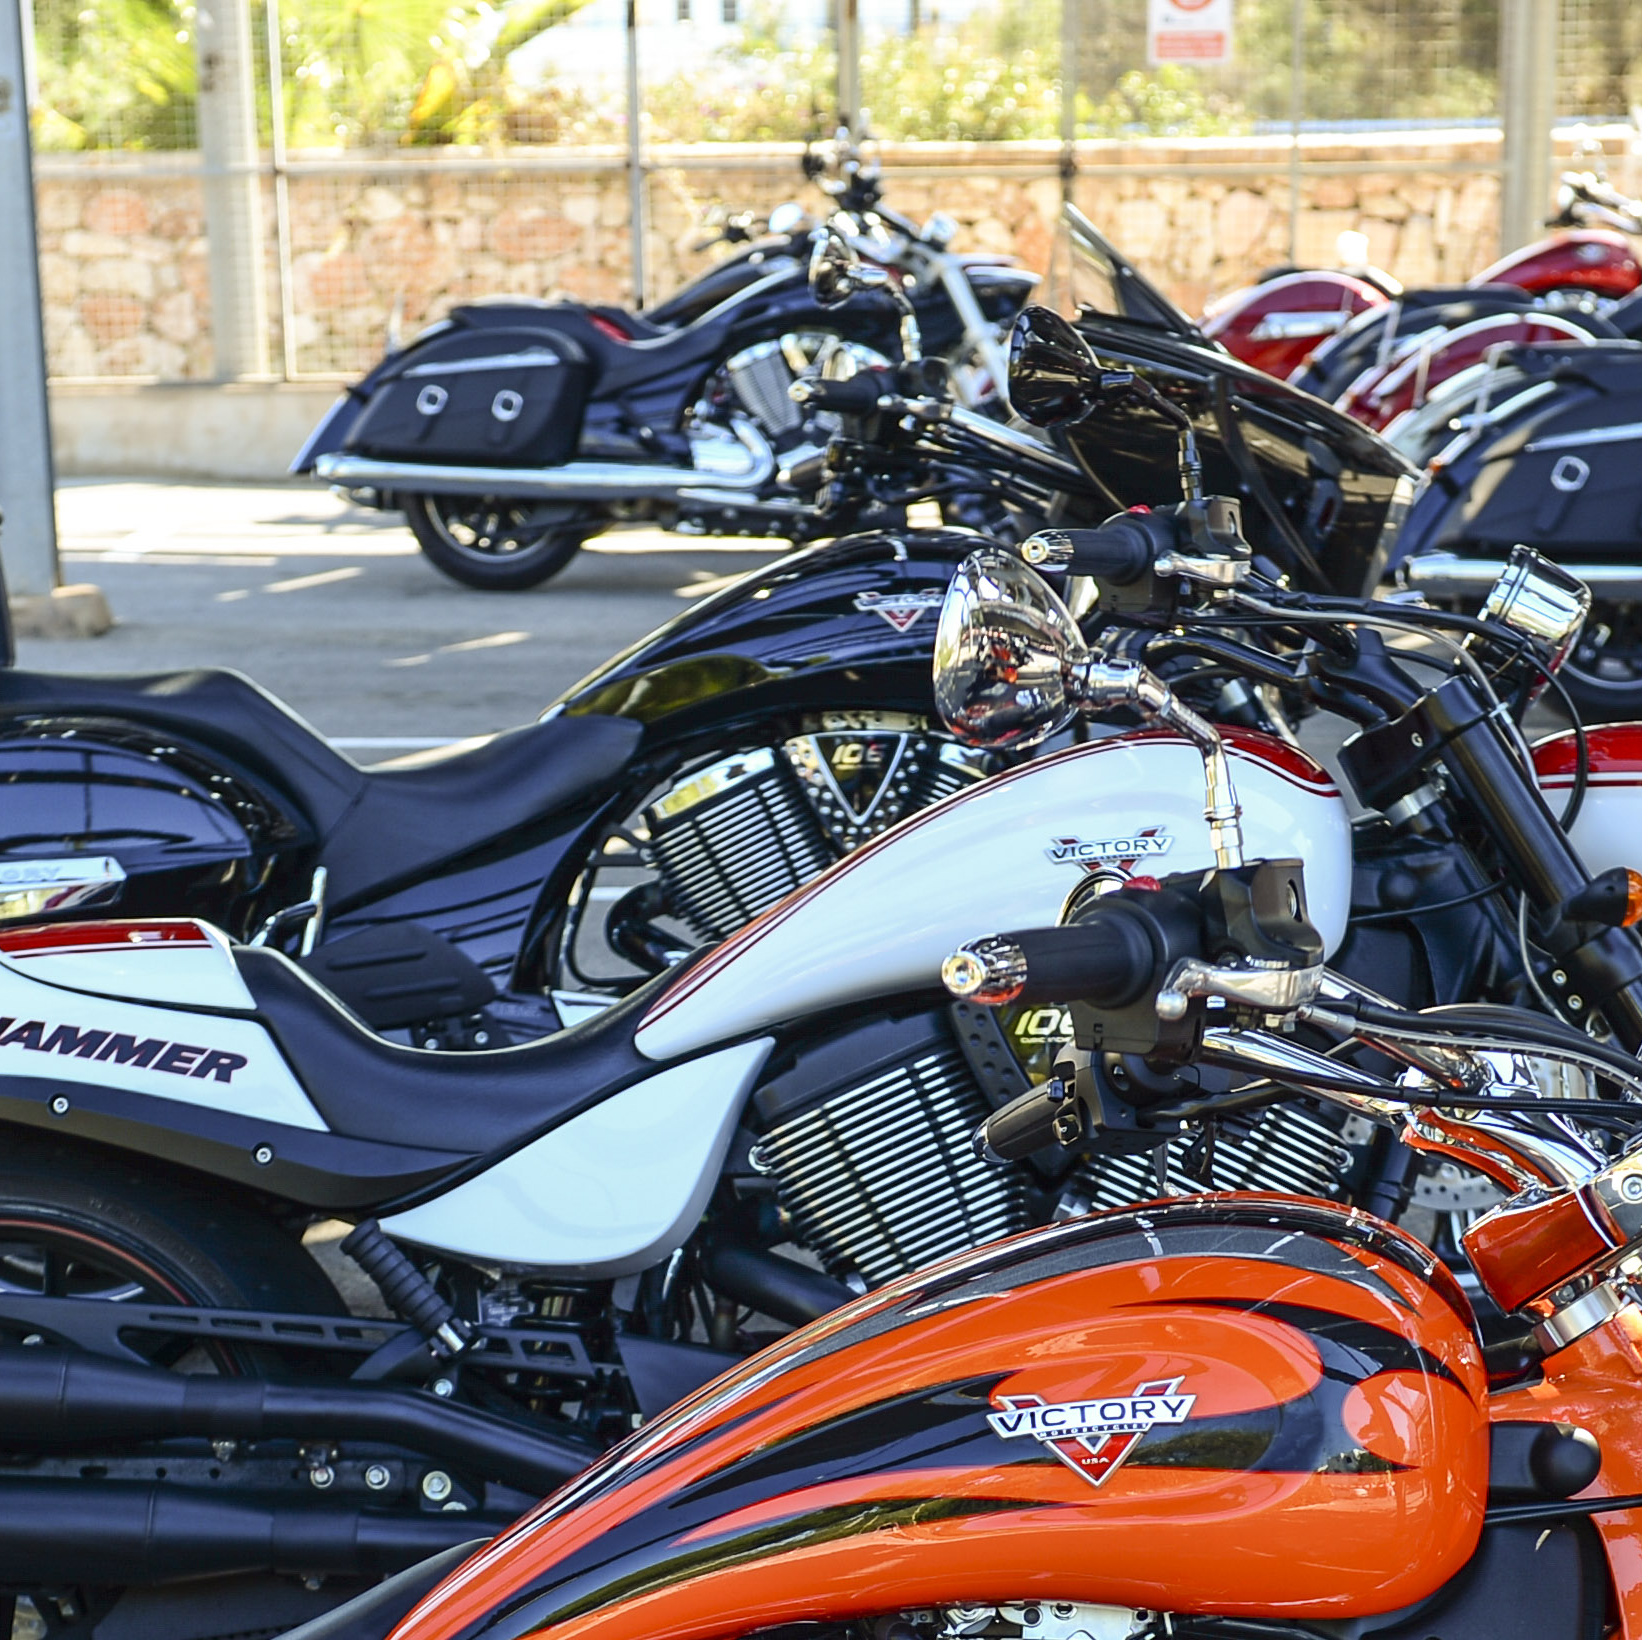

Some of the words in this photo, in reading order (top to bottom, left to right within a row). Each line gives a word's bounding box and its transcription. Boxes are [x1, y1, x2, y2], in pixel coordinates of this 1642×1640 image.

[1051, 838, 1167, 859] VICTORY
[997, 1398, 1186, 1432] VICTORY
[1038, 1422, 1150, 1438] MOTORCYCLES
[1081, 1456, 1110, 1465] USA
